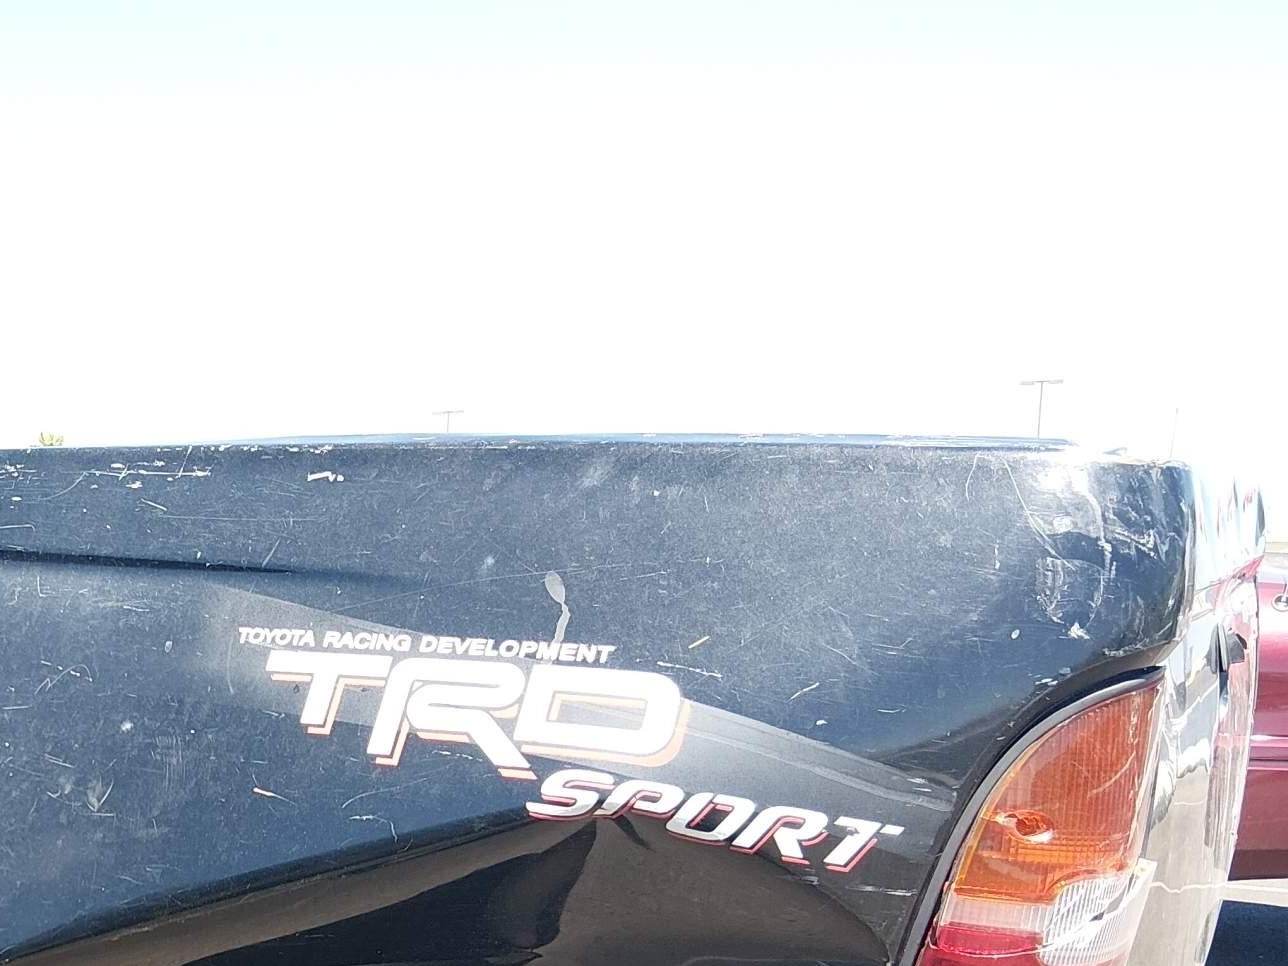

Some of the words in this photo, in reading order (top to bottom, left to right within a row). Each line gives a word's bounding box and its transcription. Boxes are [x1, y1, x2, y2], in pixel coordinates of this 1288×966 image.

[238, 626, 315, 647] TOYOTA
[322, 631, 412, 653] RACING
[418, 636, 616, 664] DEVELOPMENT
[264, 649, 689, 780] TRD
[524, 768, 905, 872] SPORT
